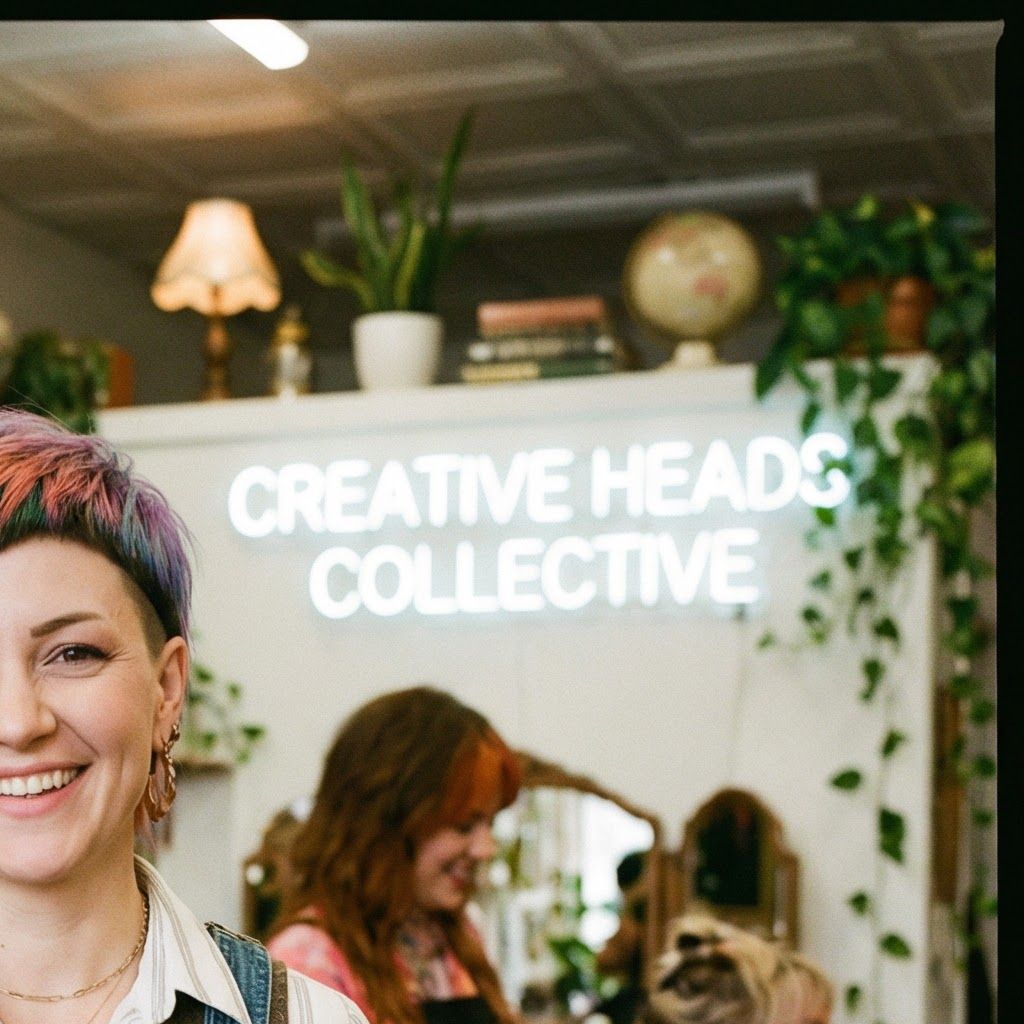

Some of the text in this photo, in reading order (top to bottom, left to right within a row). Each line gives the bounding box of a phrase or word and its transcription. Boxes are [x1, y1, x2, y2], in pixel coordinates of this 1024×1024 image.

[228, 432, 851, 537] CREATIVE HEADS
[309, 527, 760, 619] COLLECTIVE
